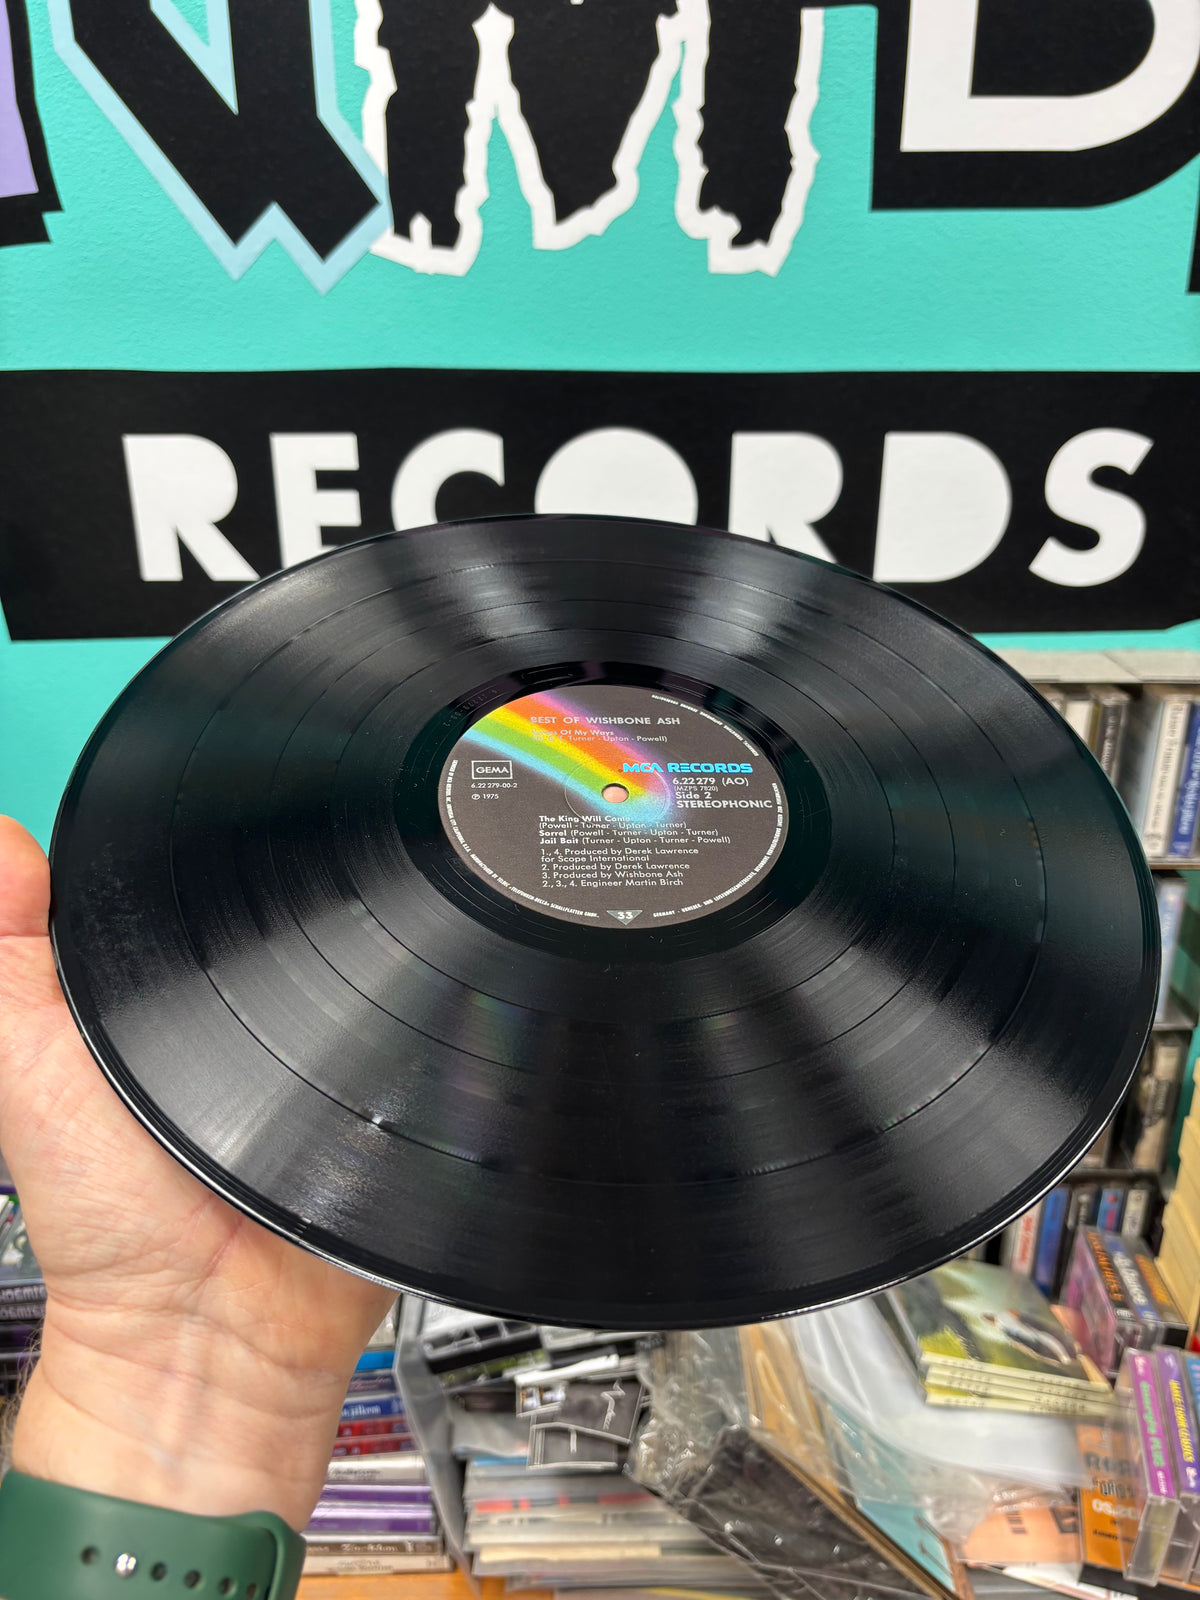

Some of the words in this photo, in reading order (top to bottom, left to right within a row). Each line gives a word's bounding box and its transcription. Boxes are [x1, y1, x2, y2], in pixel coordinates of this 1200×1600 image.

[122, 427, 1153, 588] RECORDS
[657, 717, 680, 725] ASH
[623, 763, 664, 773] MCA
[667, 763, 753, 774] RECORDS
[722, 777, 749, 786] (AO)
[677, 800, 772, 808] STEREOPHONIC
[582, 837, 611, 845] (Turner
[624, 837, 651, 845] Upton
[698, 836, 731, 844] Powell)
[610, 848, 622, 856] by
[600, 864, 612, 872] by
[600, 872, 612, 880] by
[542, 880, 554, 888] 2.,
[556, 880, 568, 888] 3.,
[581, 880, 622, 888] Engineer
[616, 912, 634, 920] 33
